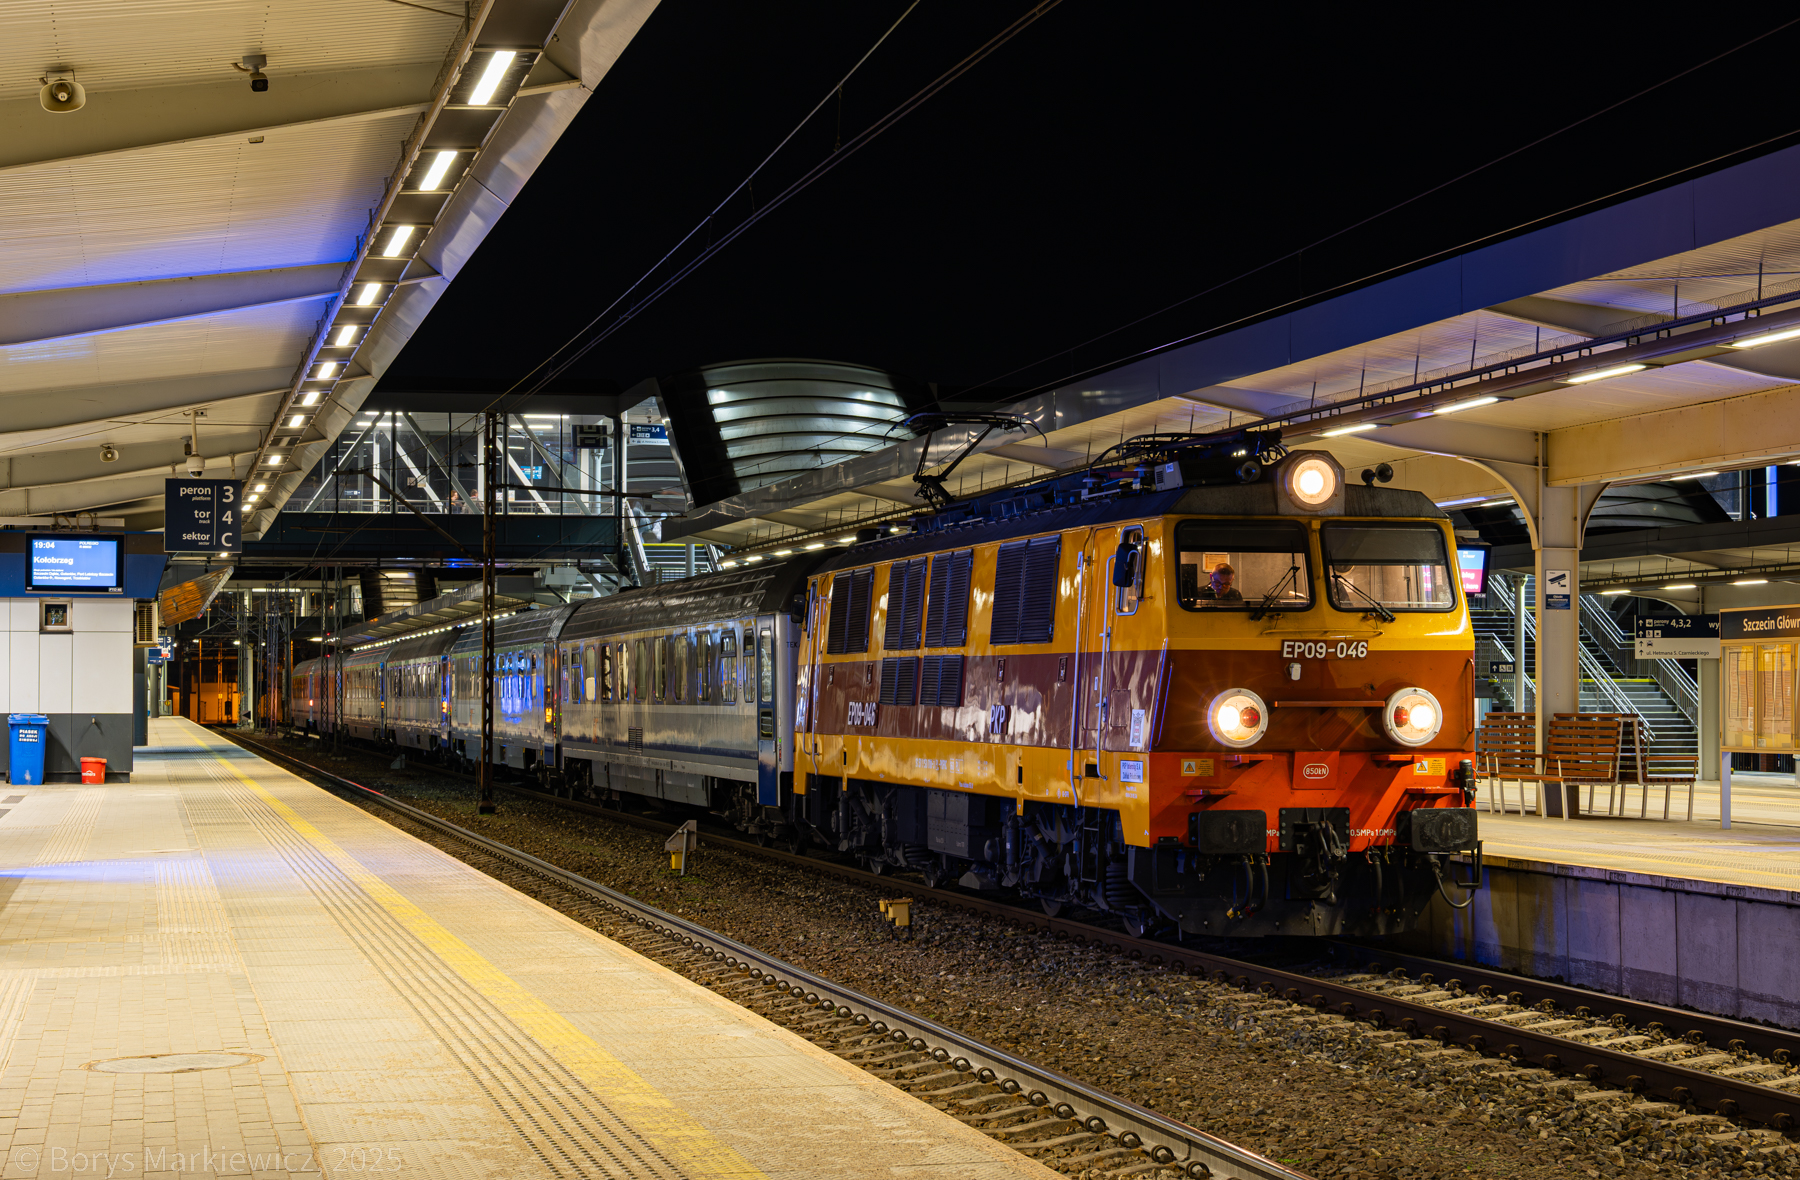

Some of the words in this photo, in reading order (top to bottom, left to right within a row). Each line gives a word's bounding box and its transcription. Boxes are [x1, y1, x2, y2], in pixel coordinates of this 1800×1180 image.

[180, 487, 211, 497] peron
[222, 485, 234, 503] 3
[194, 510, 211, 518] tor
[221, 510, 233, 525] 4
[34, 541, 55, 549] 19:04
[182, 531, 210, 541] sektor
[221, 532, 233, 547] C
[1670, 618, 1691, 629] 4,3,2
[1743, 616, 1775, 632] Szczecin
[1282, 641, 1368, 659] EP09-046
[847, 701, 876, 727] EP09-046
[989, 704, 1006, 734] PKP
[1305, 767, 1327, 775] 850kN
[1350, 828, 1374, 838] 0,5MPa
